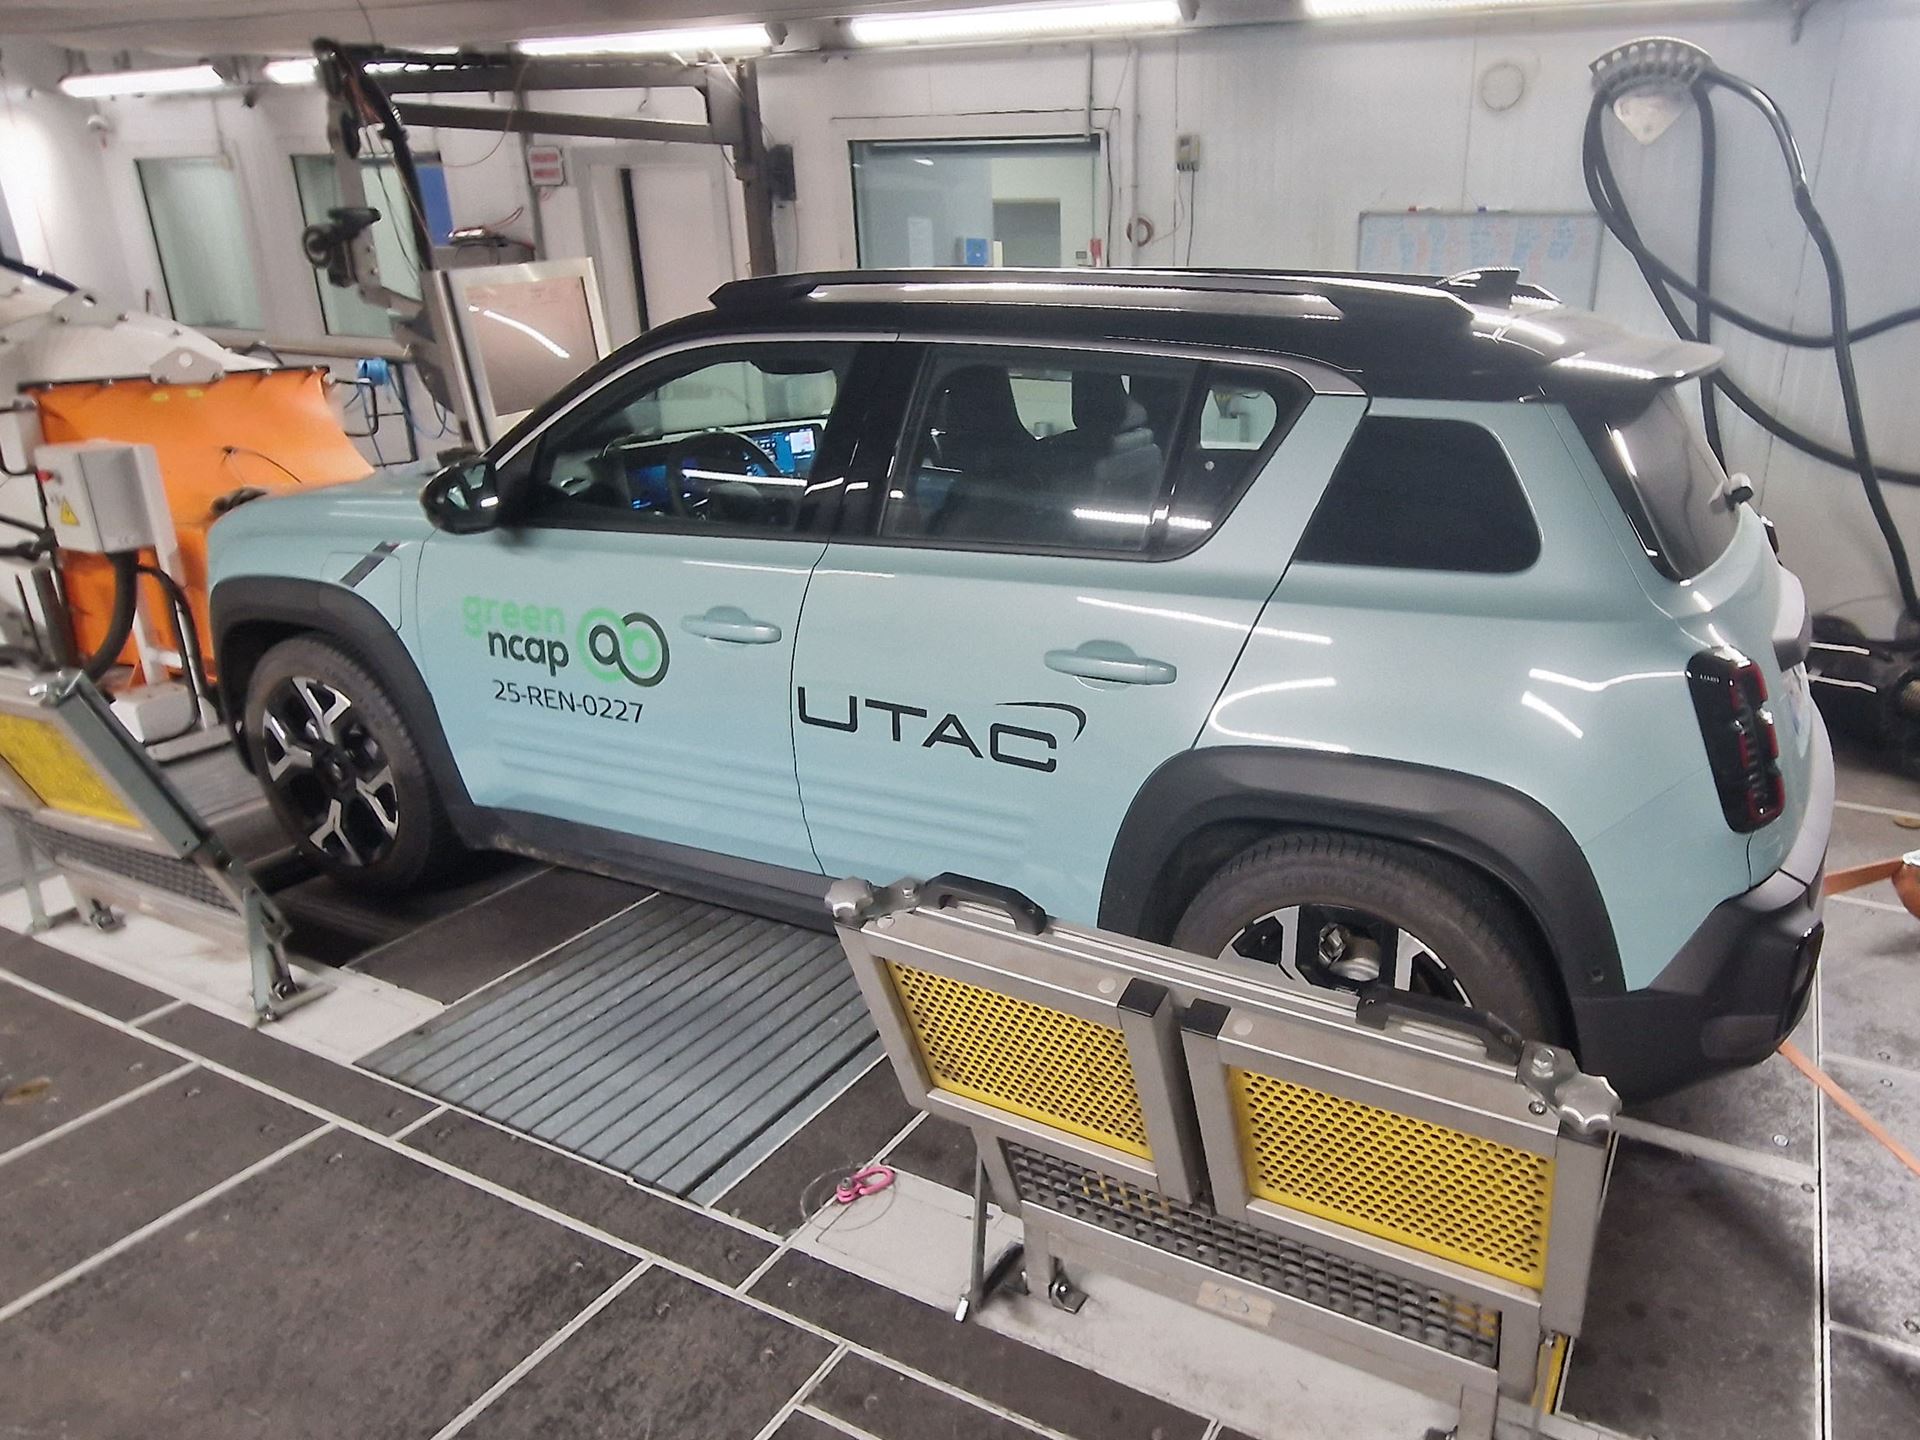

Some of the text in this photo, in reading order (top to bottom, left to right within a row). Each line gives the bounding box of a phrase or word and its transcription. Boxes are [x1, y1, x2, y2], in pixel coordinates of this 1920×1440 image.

[463, 596, 565, 639] green
[488, 631, 569, 677] ncap
[493, 680, 644, 723] 25-REN-0227
[798, 687, 1056, 772] UTAC
